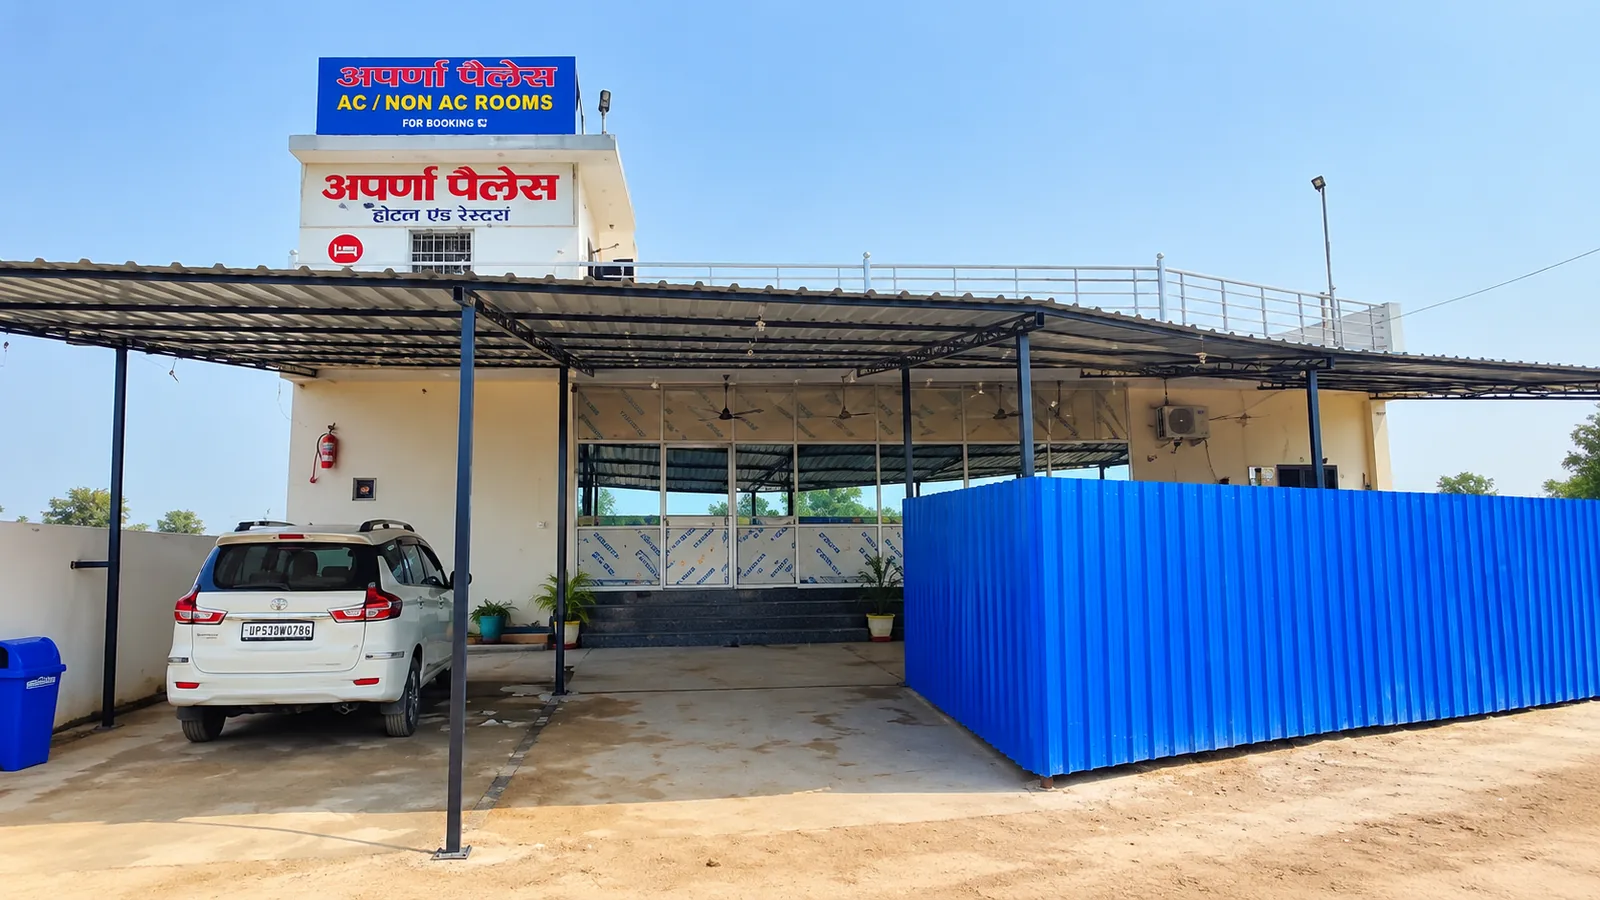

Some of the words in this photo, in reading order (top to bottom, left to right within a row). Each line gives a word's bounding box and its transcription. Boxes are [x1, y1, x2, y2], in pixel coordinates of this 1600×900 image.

[336, 59, 449, 88] अपर्णा
[456, 59, 558, 88] पैलेस
[337, 94, 367, 110] AC
[372, 94, 380, 110] /
[385, 94, 432, 110] NON
[438, 94, 468, 110] AC
[475, 94, 553, 110] ROOMS
[402, 118, 423, 128] FOR
[426, 118, 474, 128] BOOKING
[321, 165, 438, 201] अपर्णा
[446, 165, 560, 201] पैलेस
[372, 205, 420, 223] होटल
[426, 207, 452, 222] एंड
